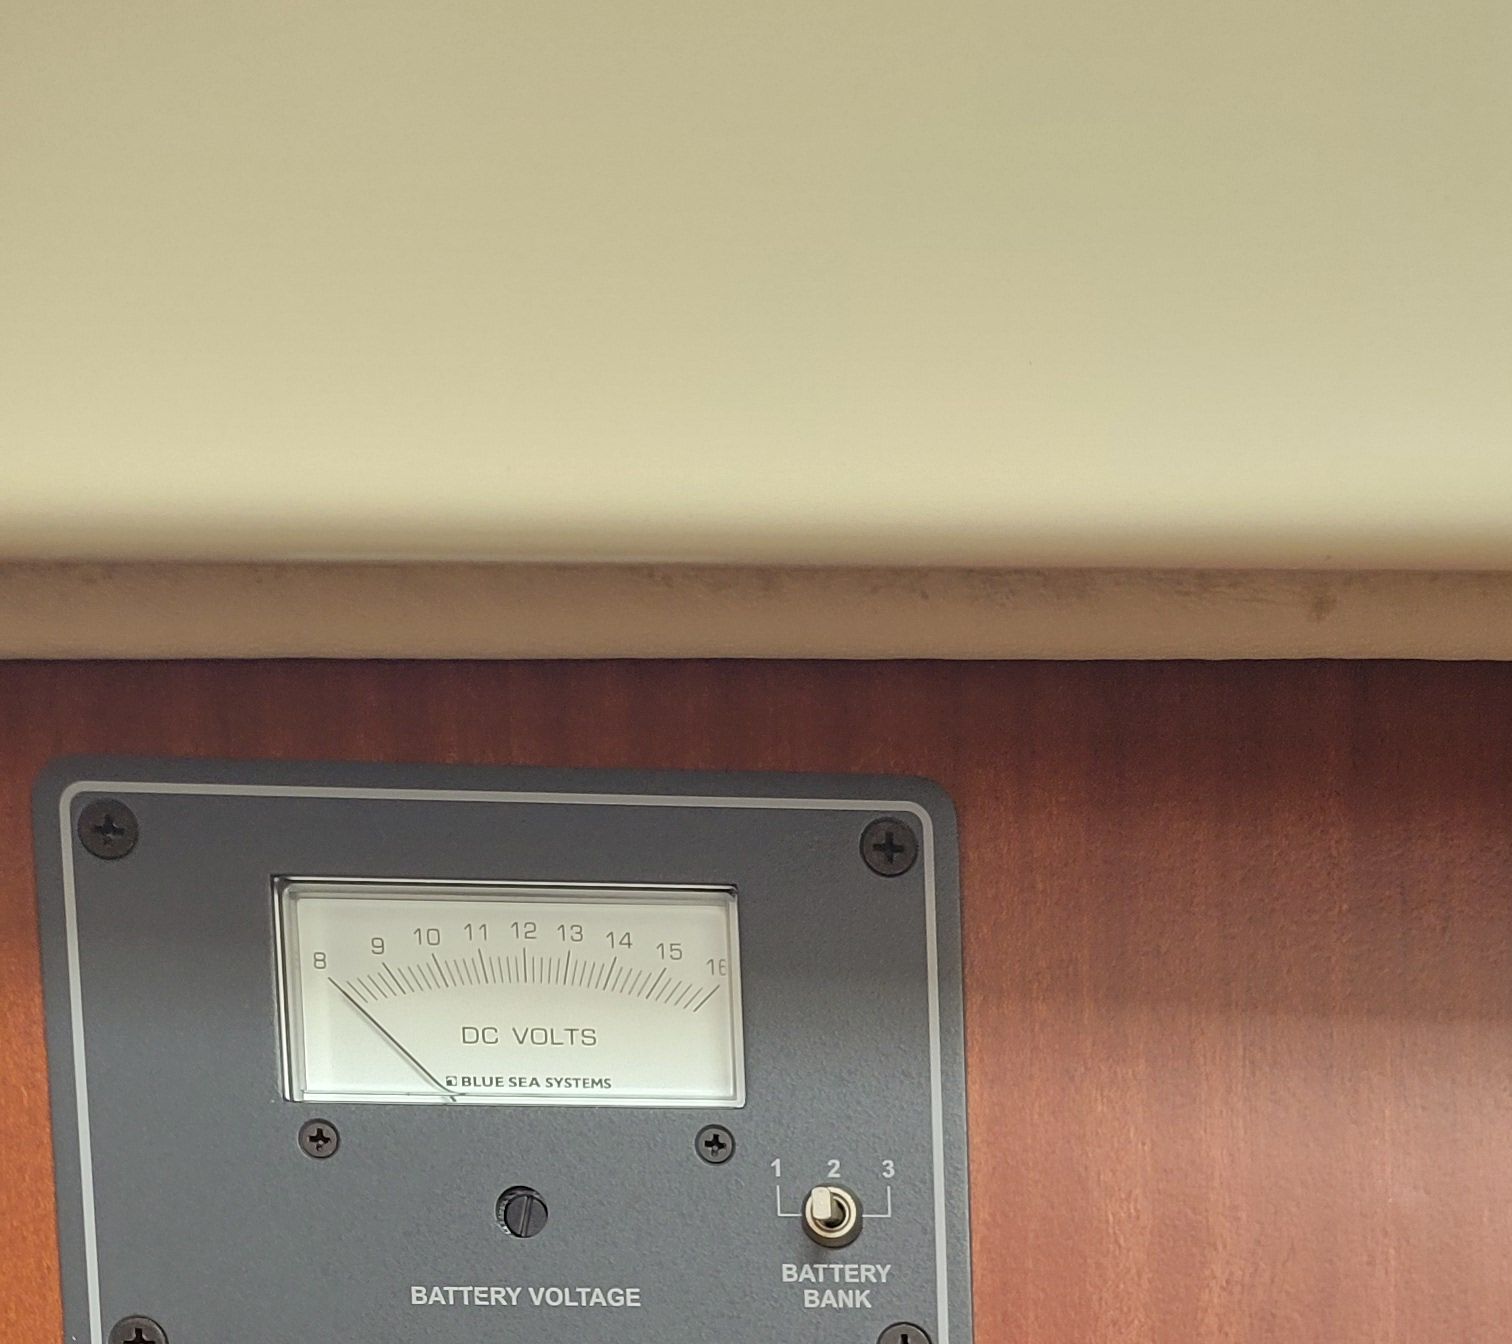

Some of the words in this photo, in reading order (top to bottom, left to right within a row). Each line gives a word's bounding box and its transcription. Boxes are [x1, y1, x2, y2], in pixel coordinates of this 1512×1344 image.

[314, 952, 326, 969] 8
[372, 938, 384, 954] 9
[414, 928, 440, 945] 10
[465, 924, 486, 940] 11
[512, 922, 536, 939] 12
[558, 925, 583, 941] 13
[607, 932, 632, 948] 14
[657, 943, 682, 960] 15
[706, 958, 728, 977] 16
[462, 1027, 498, 1044] DC
[513, 1028, 596, 1045] VOLTS
[462, 1077, 503, 1087] BLUE
[509, 1077, 540, 1087] SEA
[546, 1078, 611, 1088] SYSTEMS
[771, 1159, 780, 1176] 1
[828, 1160, 840, 1177] 2
[883, 1160, 894, 1177] 3
[782, 1262, 891, 1282] BATTERY
[412, 1287, 521, 1305] BATTERY
[529, 1288, 640, 1306] VOLTAGE
[804, 1290, 871, 1308] BANK
